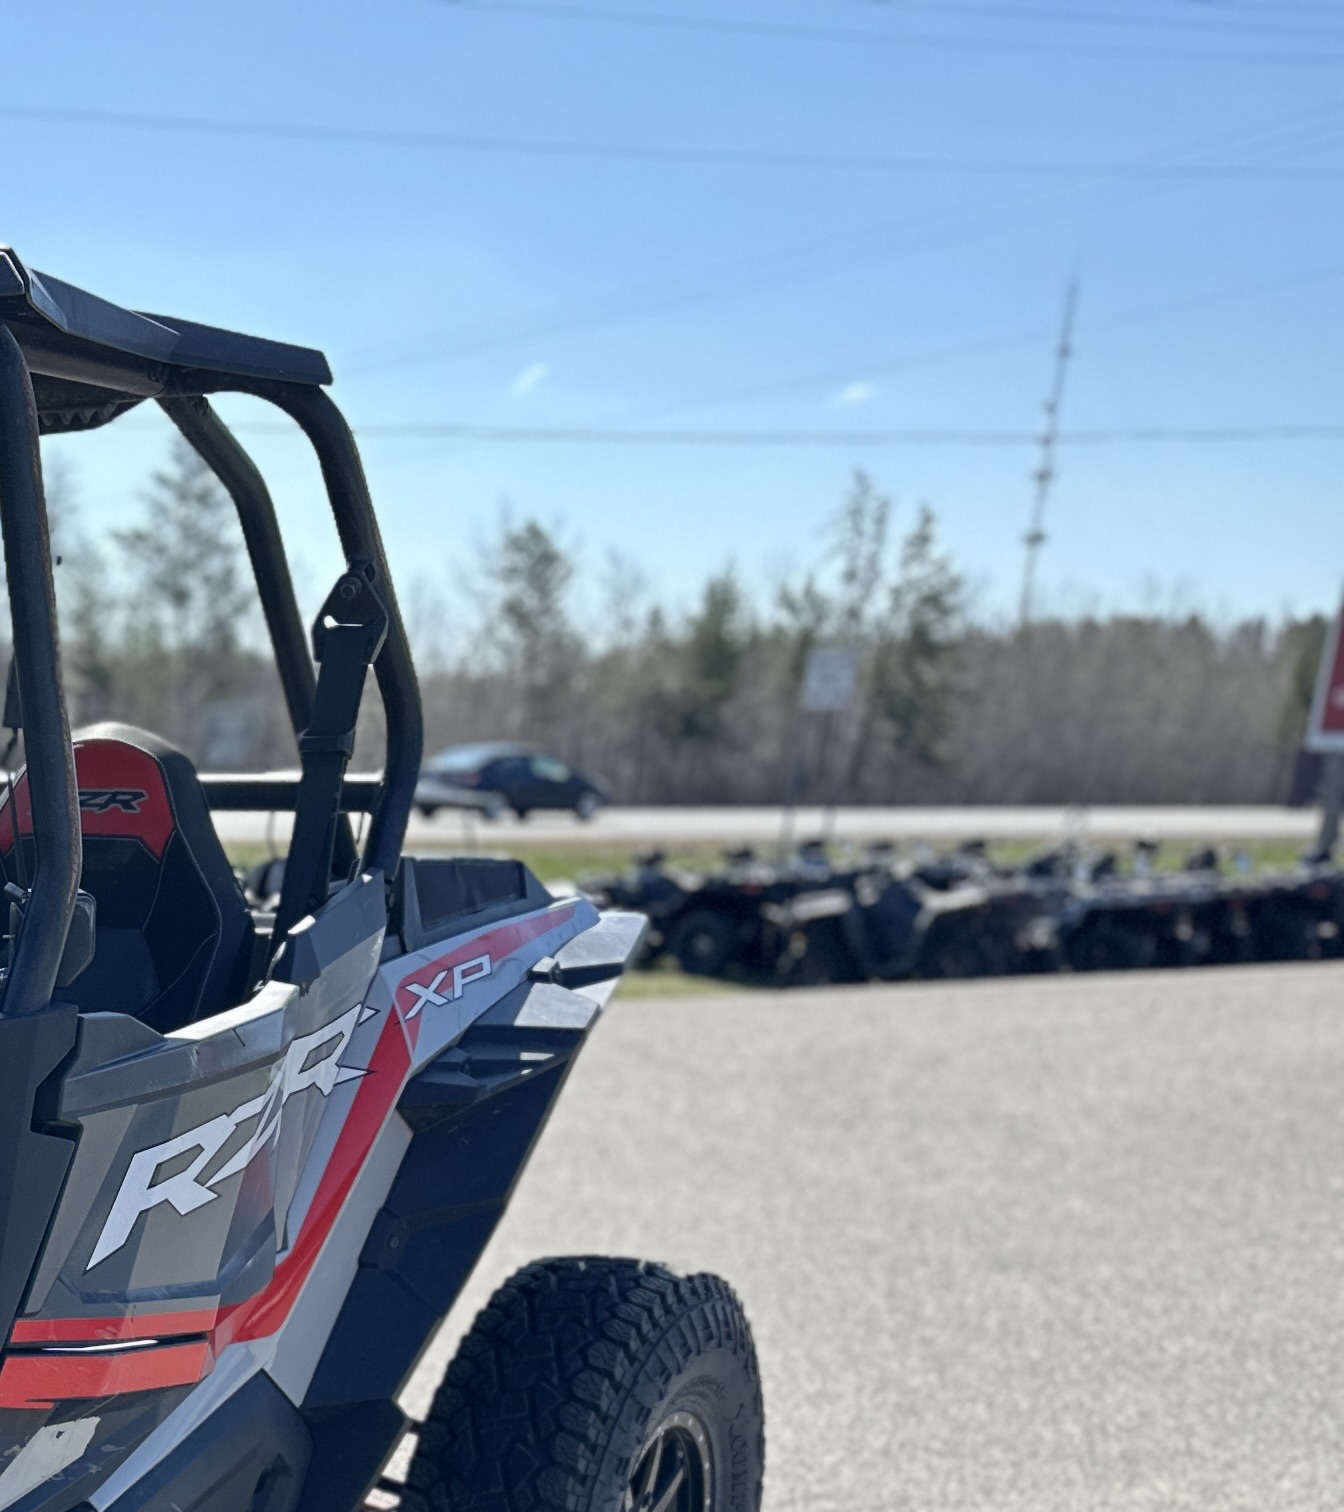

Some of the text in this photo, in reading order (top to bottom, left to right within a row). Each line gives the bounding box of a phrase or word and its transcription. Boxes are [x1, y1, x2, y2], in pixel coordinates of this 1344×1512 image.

[78, 788, 148, 814] ZR
[404, 953, 492, 1020] XP
[83, 1003, 380, 1276] RZR
